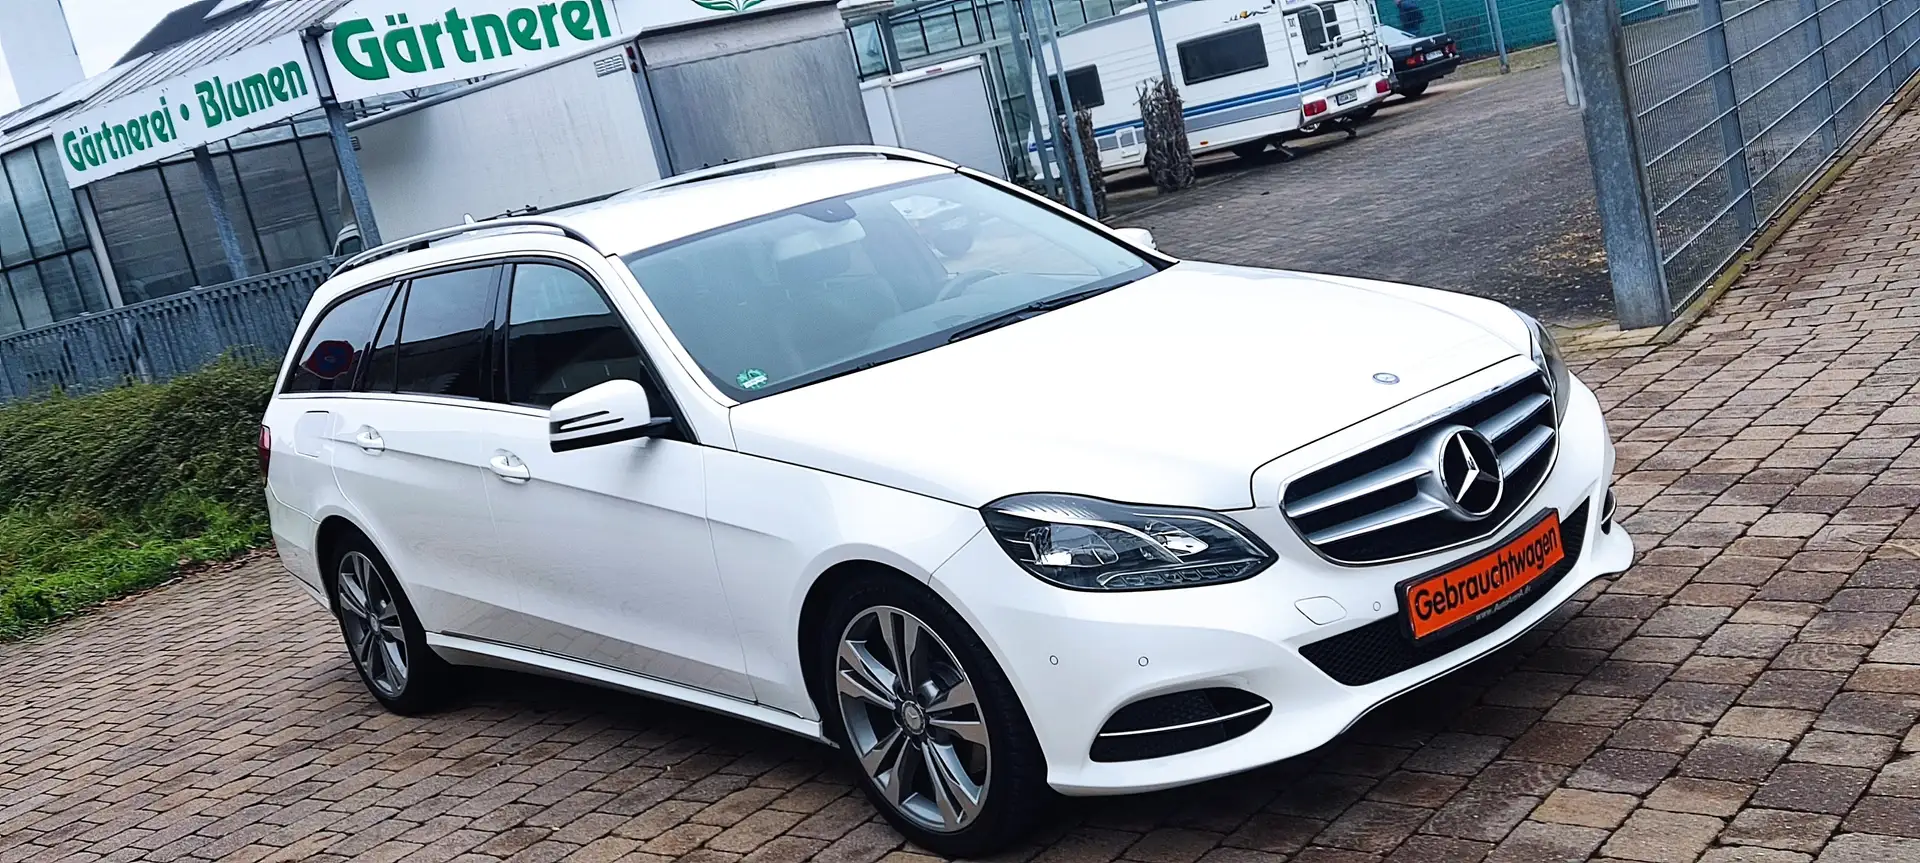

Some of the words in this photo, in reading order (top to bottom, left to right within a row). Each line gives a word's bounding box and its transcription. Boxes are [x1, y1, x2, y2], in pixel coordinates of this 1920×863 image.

[332, 0, 611, 80] Gärtnerei
[63, 98, 176, 171] Gärtnerei
[196, 62, 306, 127] Blumen
[1415, 526, 1557, 620] Gebrauchtwagen
